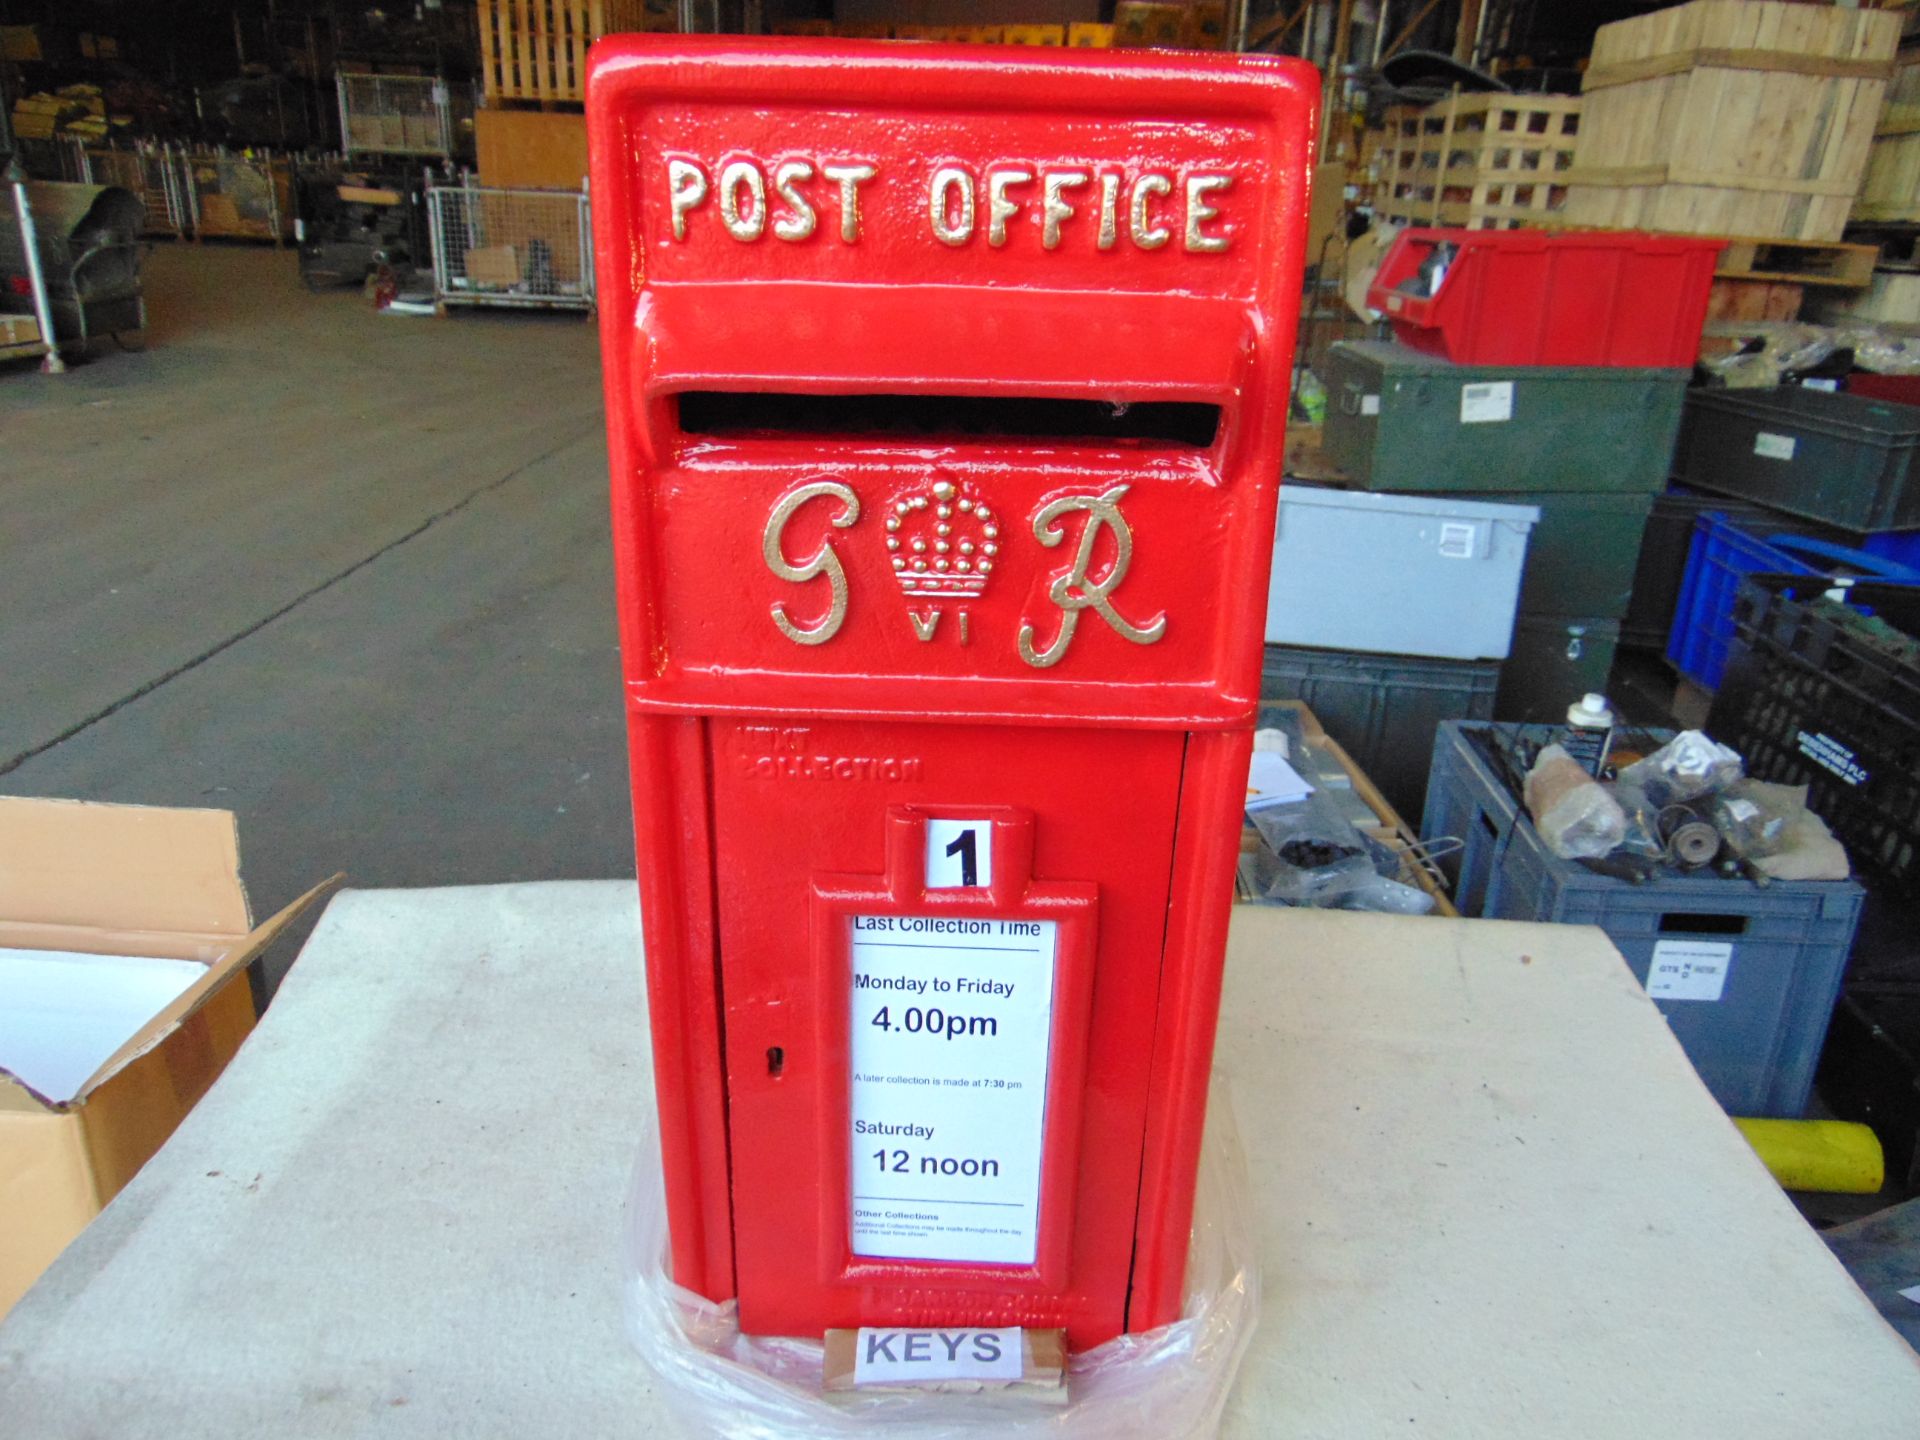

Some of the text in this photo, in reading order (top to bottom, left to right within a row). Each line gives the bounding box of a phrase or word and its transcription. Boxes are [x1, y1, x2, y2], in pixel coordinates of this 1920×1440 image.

[668, 159, 1233, 252] POST OFFICE
[762, 480, 1166, 668] G R
[909, 610, 969, 646] VI
[945, 829, 977, 886] 1
[855, 916, 895, 931] Last
[899, 918, 992, 934] Collection
[855, 974, 1015, 999] Monday to Friday
[871, 1006, 998, 1041] 4.00pm
[854, 1073, 1022, 1090] A later collection is made at 7:30 pm
[855, 1120, 935, 1140] Saturday
[873, 1149, 999, 1177] 12 noon
[854, 1209, 939, 1221] Other Collections
[866, 1333, 1002, 1364] KEYS
